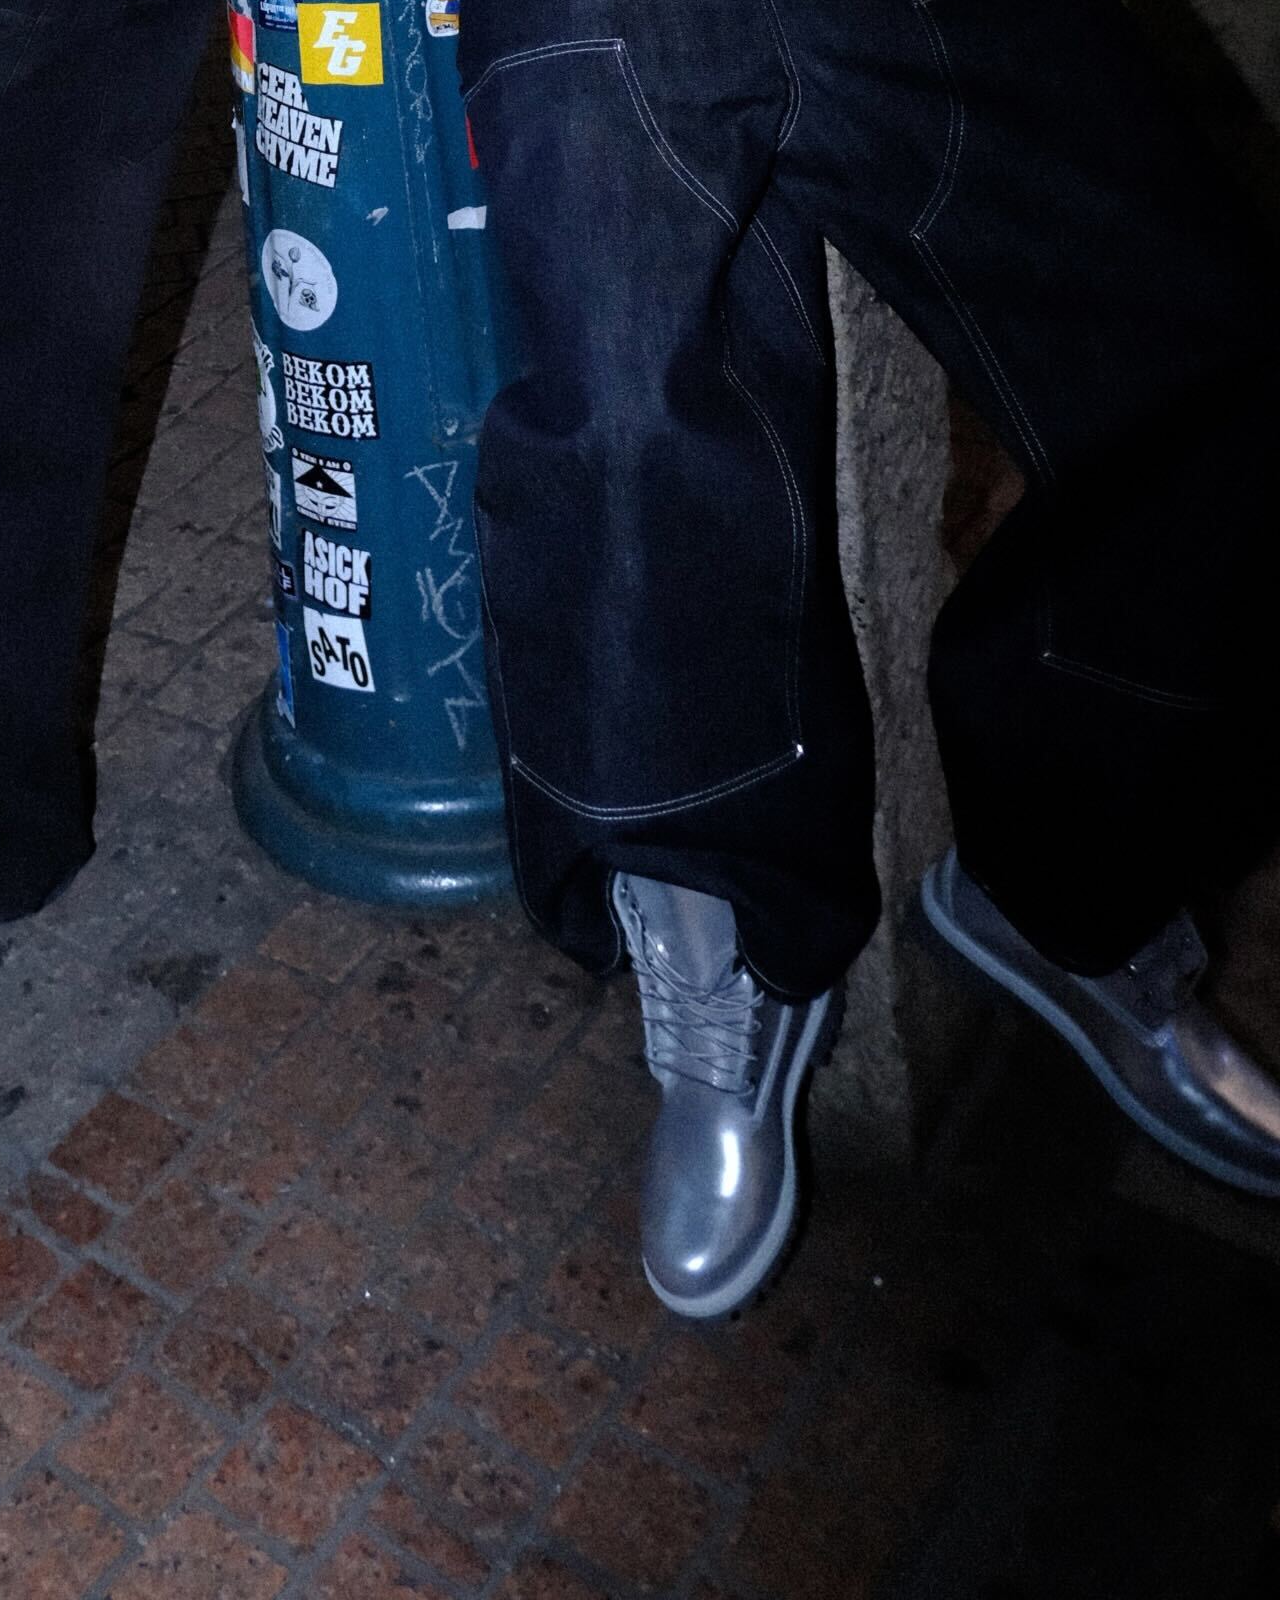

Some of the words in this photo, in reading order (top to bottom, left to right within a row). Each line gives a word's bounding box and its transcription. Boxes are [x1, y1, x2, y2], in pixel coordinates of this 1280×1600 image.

[257, 92, 344, 154] HEAVEN
[255, 122, 338, 189] CHYME
[282, 352, 371, 389] BEKOM
[284, 376, 374, 414] BEKOM
[286, 401, 377, 439] BEKOM
[304, 530, 371, 587] ASICK
[304, 563, 369, 616] HOF
[310, 626, 369, 688] SATO
